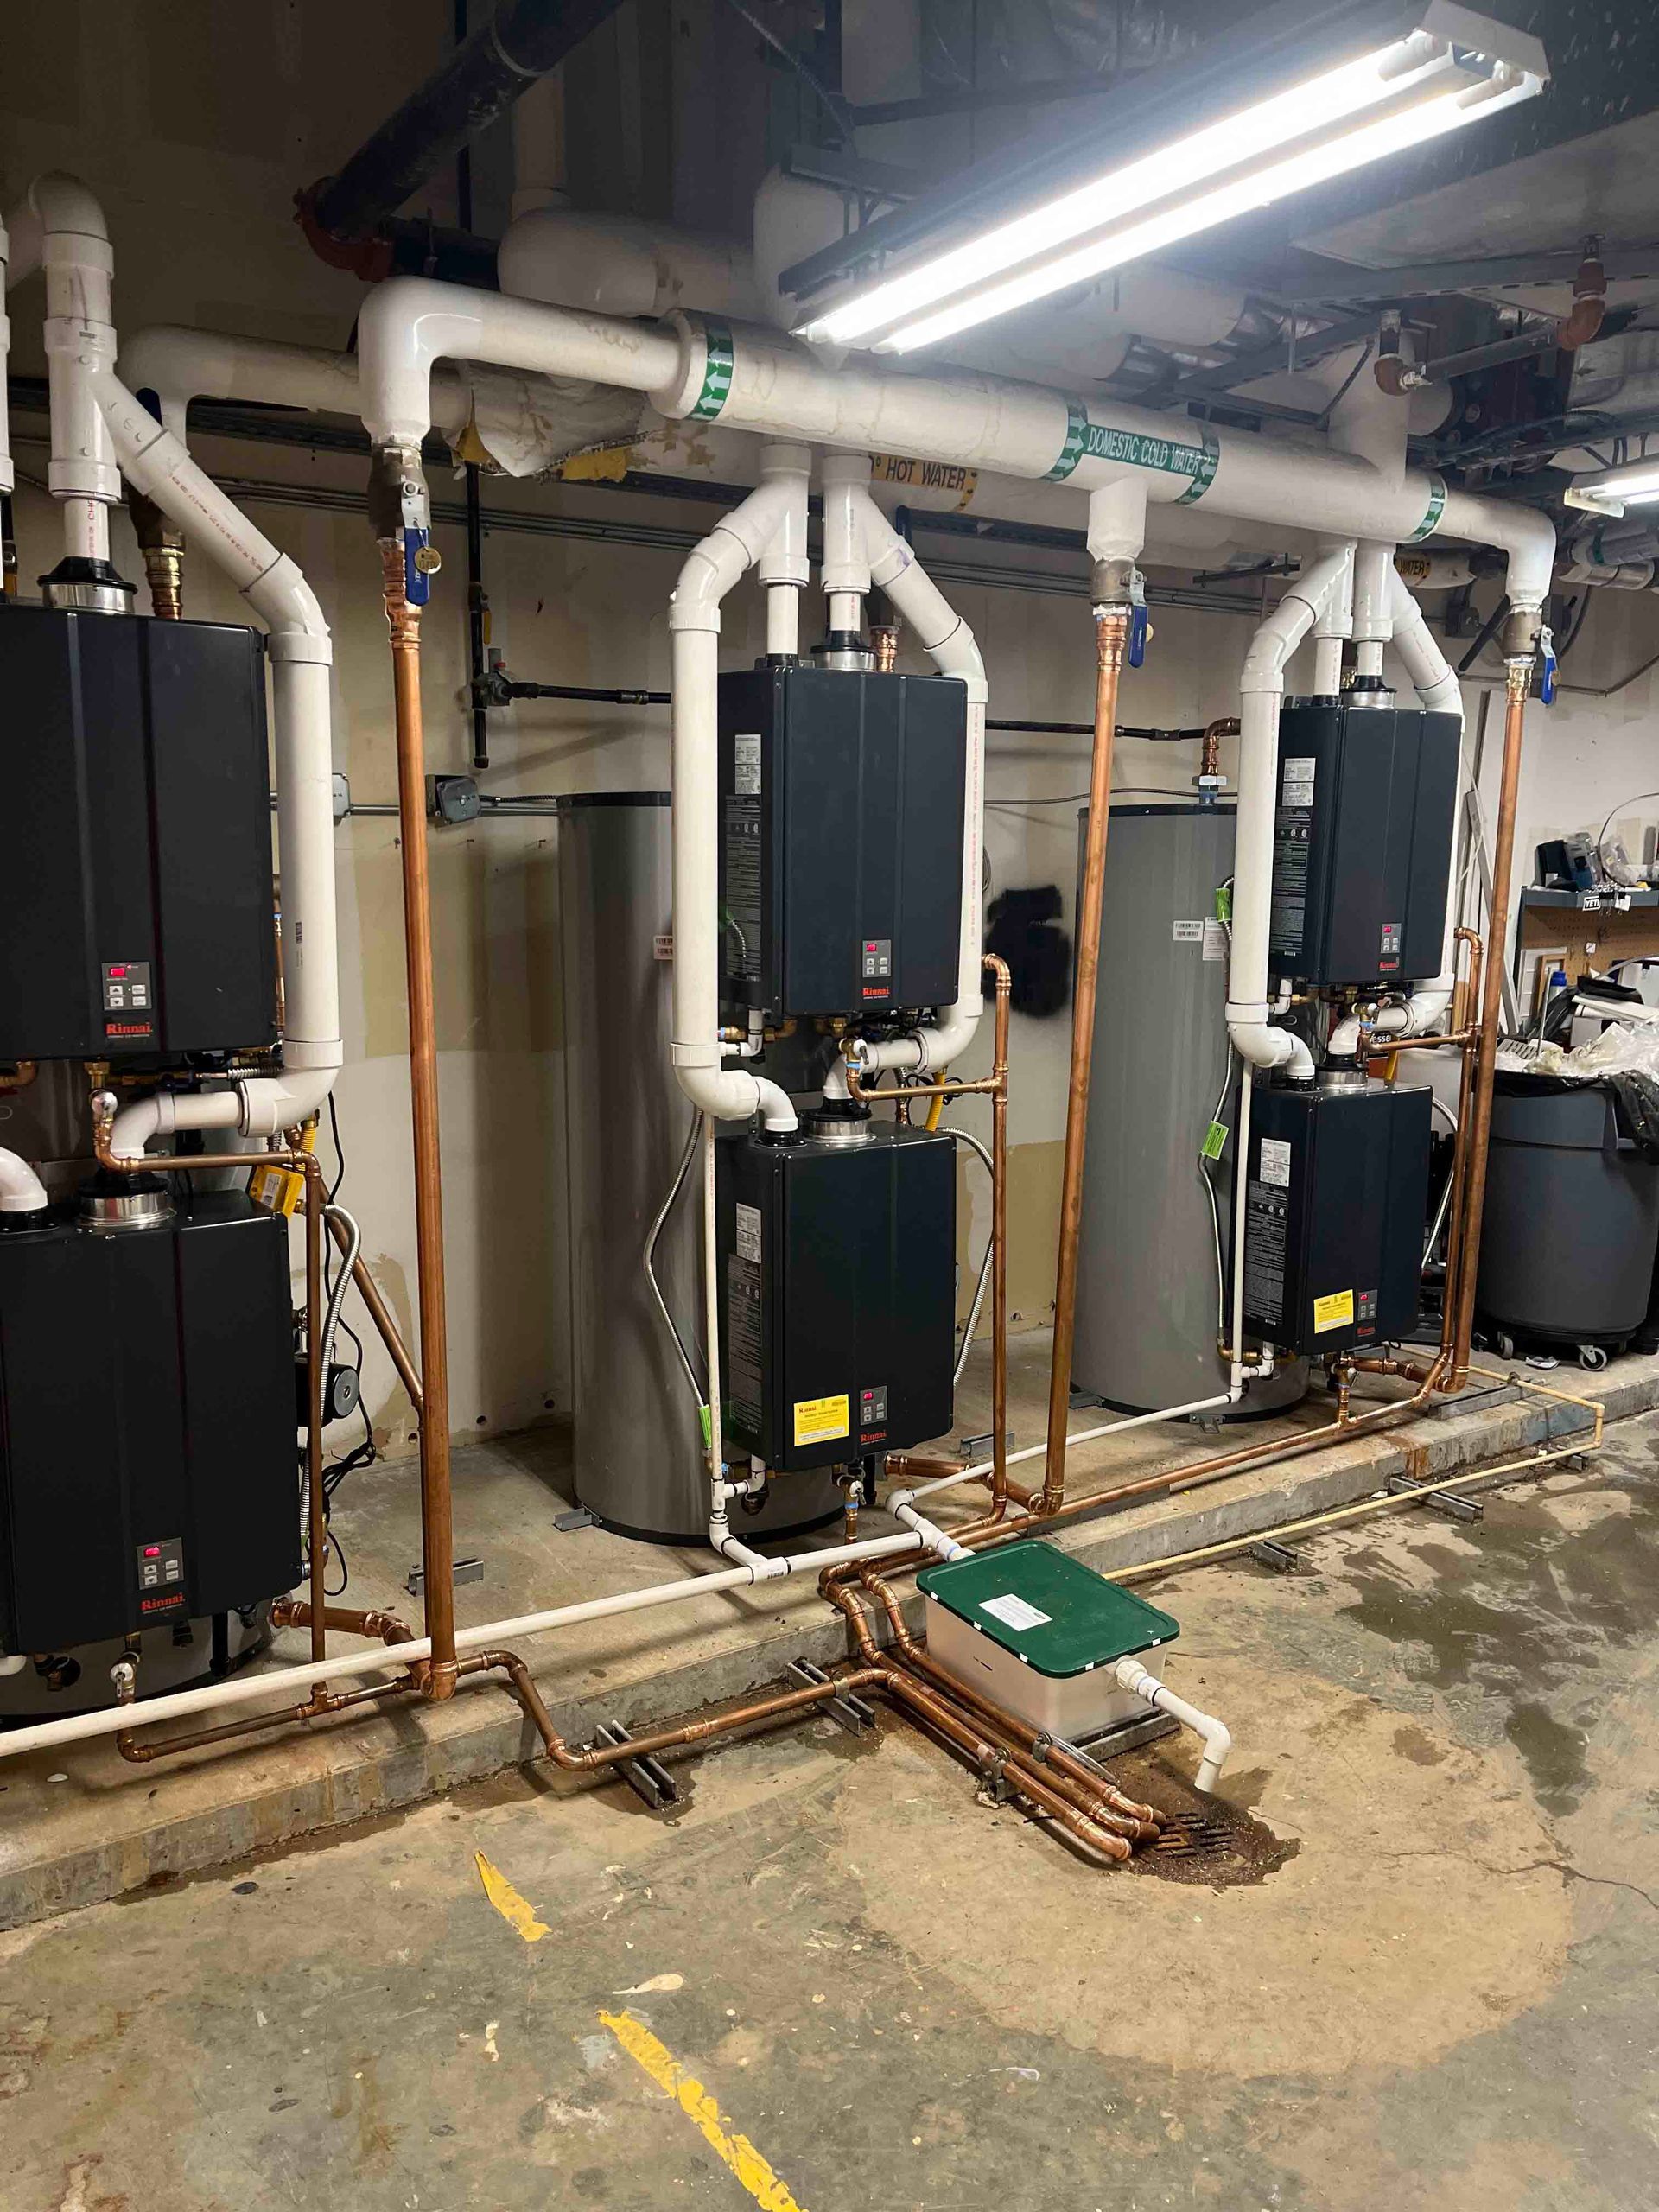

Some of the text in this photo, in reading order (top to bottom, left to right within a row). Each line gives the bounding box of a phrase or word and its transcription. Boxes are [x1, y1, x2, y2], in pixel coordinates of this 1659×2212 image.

[1087, 427, 1203, 474] DOMESTIC COLD WATER
[886, 457, 916, 482] HOT
[921, 461, 967, 490] WATER
[1586, 899, 1599, 908] YETI
[106, 1023, 152, 1034] Rinnai
[141, 1592, 186, 1611] Rinnai
